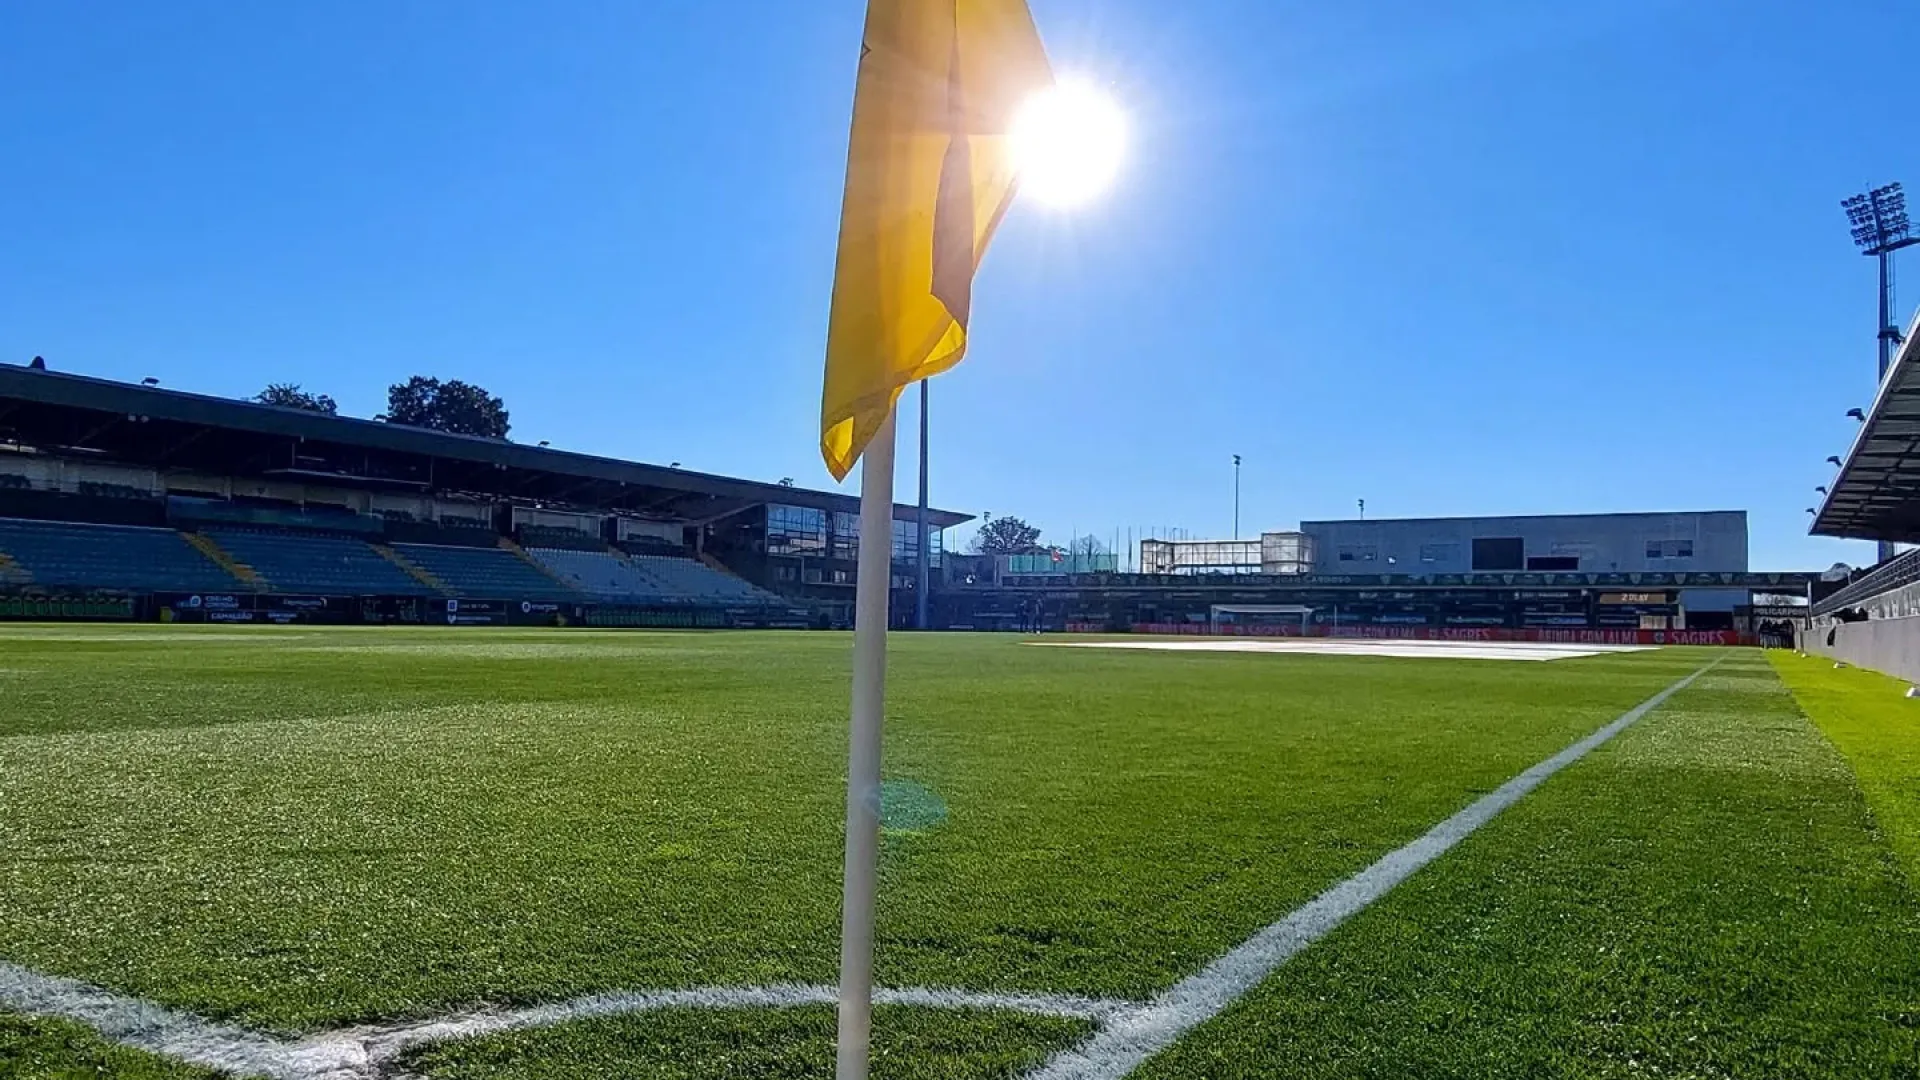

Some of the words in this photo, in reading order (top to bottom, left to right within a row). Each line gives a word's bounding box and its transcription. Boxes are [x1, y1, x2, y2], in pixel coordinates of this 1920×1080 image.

[1442, 628, 1490, 639] SAGRES
[1579, 629, 1605, 641] COM
[1608, 630, 1639, 642] ALMA
[1671, 631, 1726, 644] SAGRES
